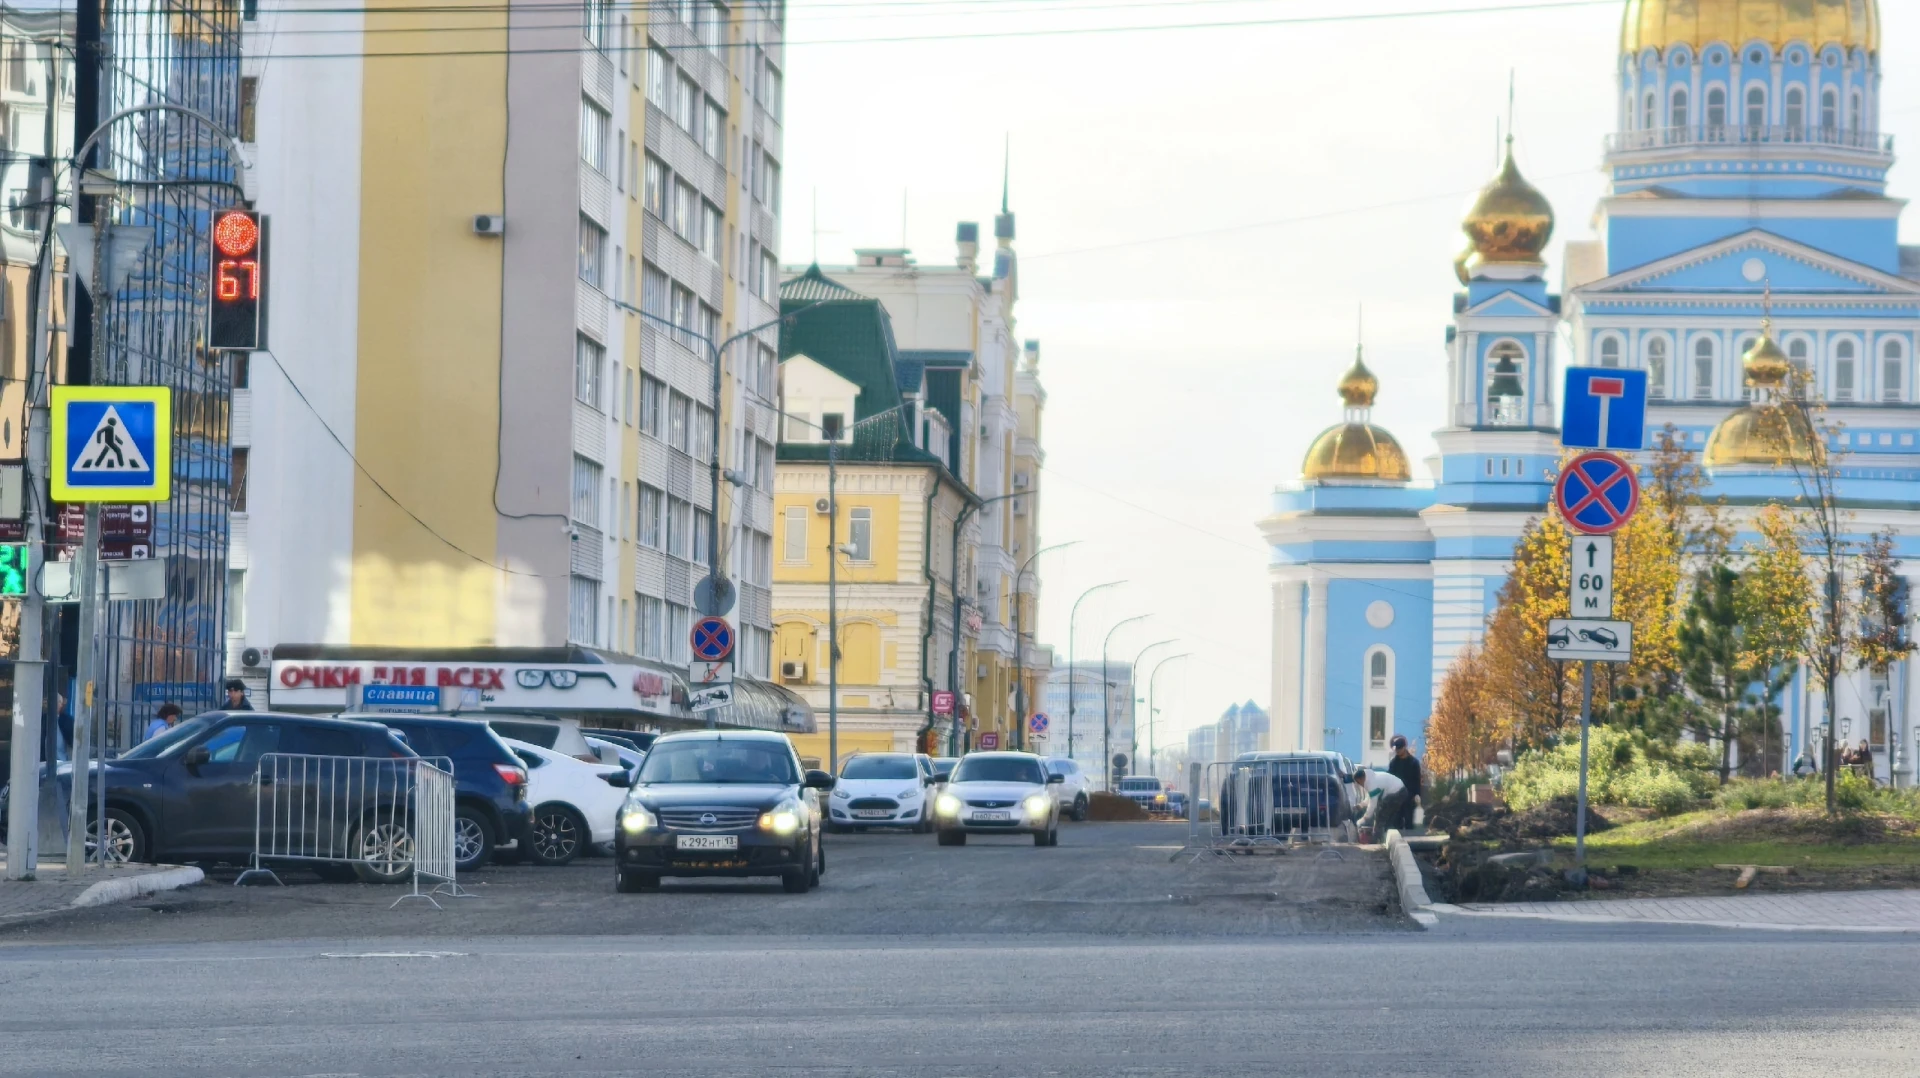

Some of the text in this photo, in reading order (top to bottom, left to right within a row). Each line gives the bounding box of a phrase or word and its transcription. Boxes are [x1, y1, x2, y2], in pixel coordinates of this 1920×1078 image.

[219, 261, 258, 300] 67
[1579, 573, 1603, 590] 60
[280, 665, 361, 688] ОЧКИ
[437, 667, 504, 690] ВСЕХ
[367, 689, 436, 701] славица
